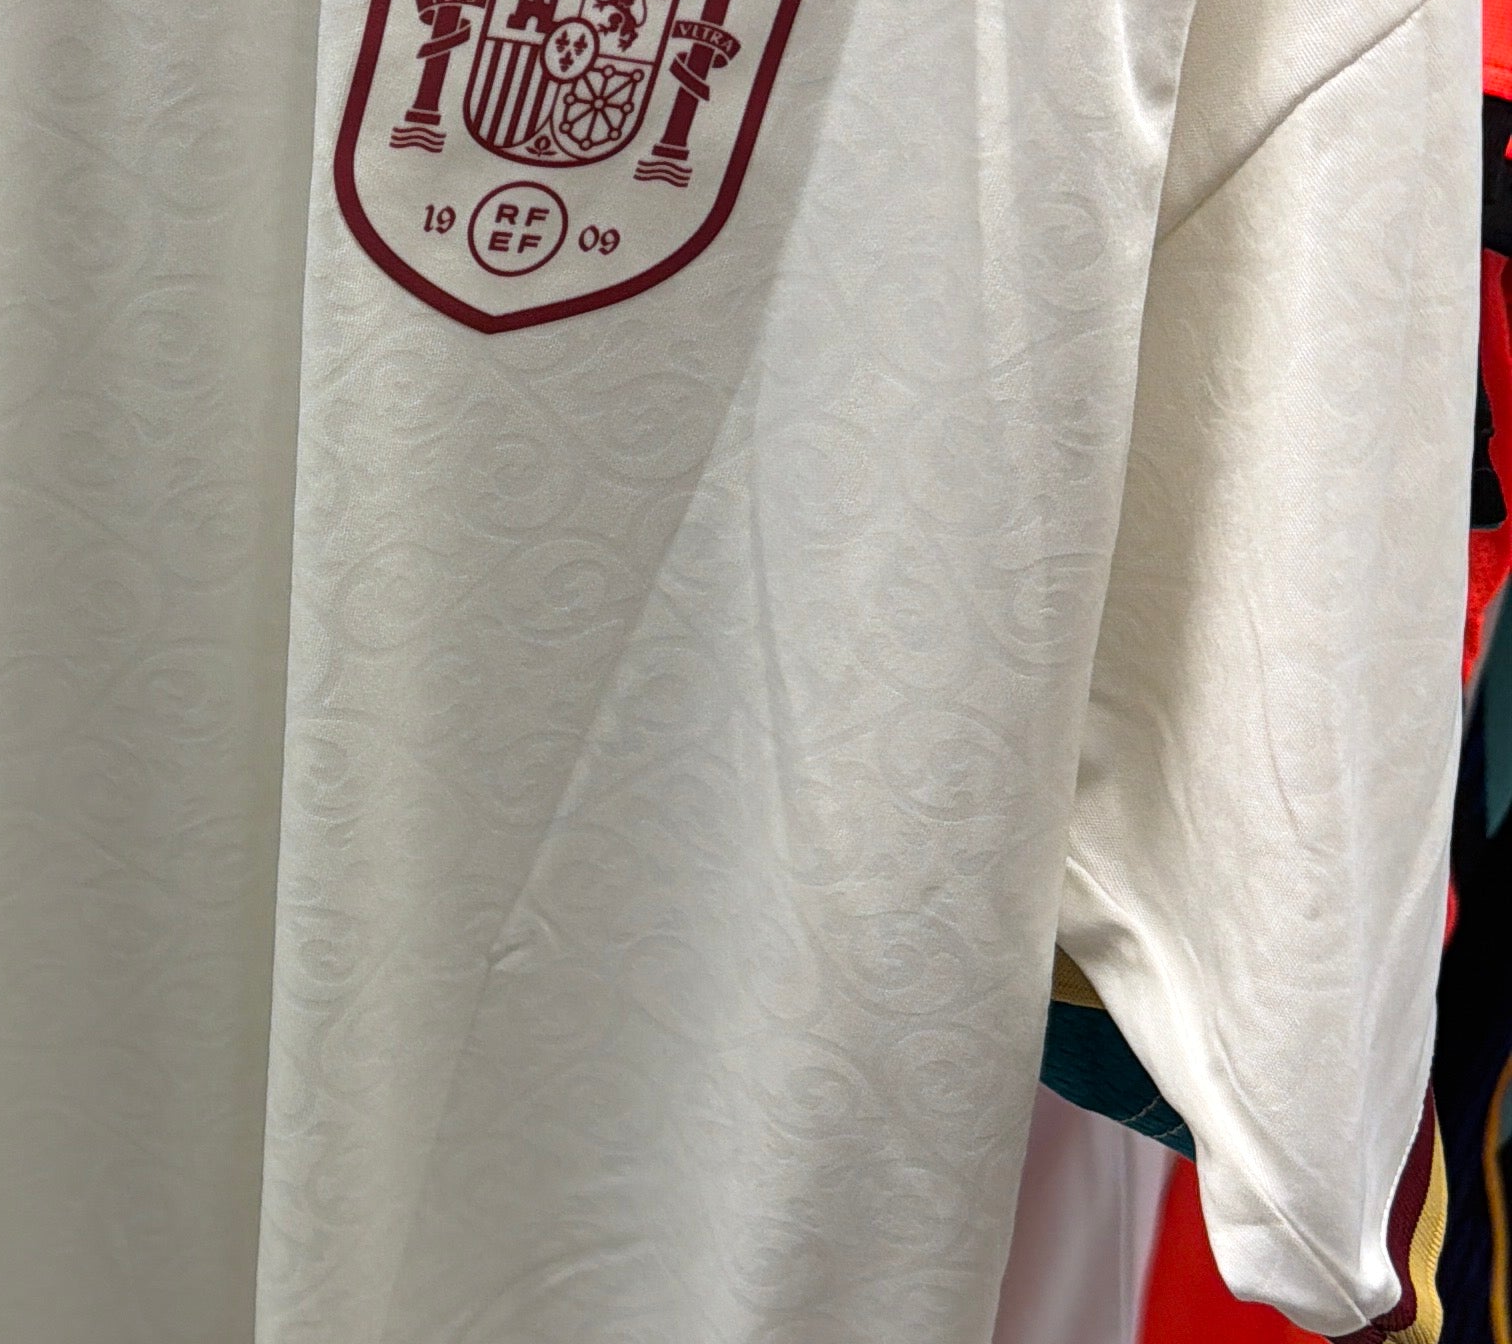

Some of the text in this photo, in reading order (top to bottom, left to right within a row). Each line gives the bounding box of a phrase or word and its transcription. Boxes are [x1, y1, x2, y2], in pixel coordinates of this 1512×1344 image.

[679, 23, 734, 53] VLTRA
[423, 203, 457, 235] 19
[577, 224, 621, 256] 09
